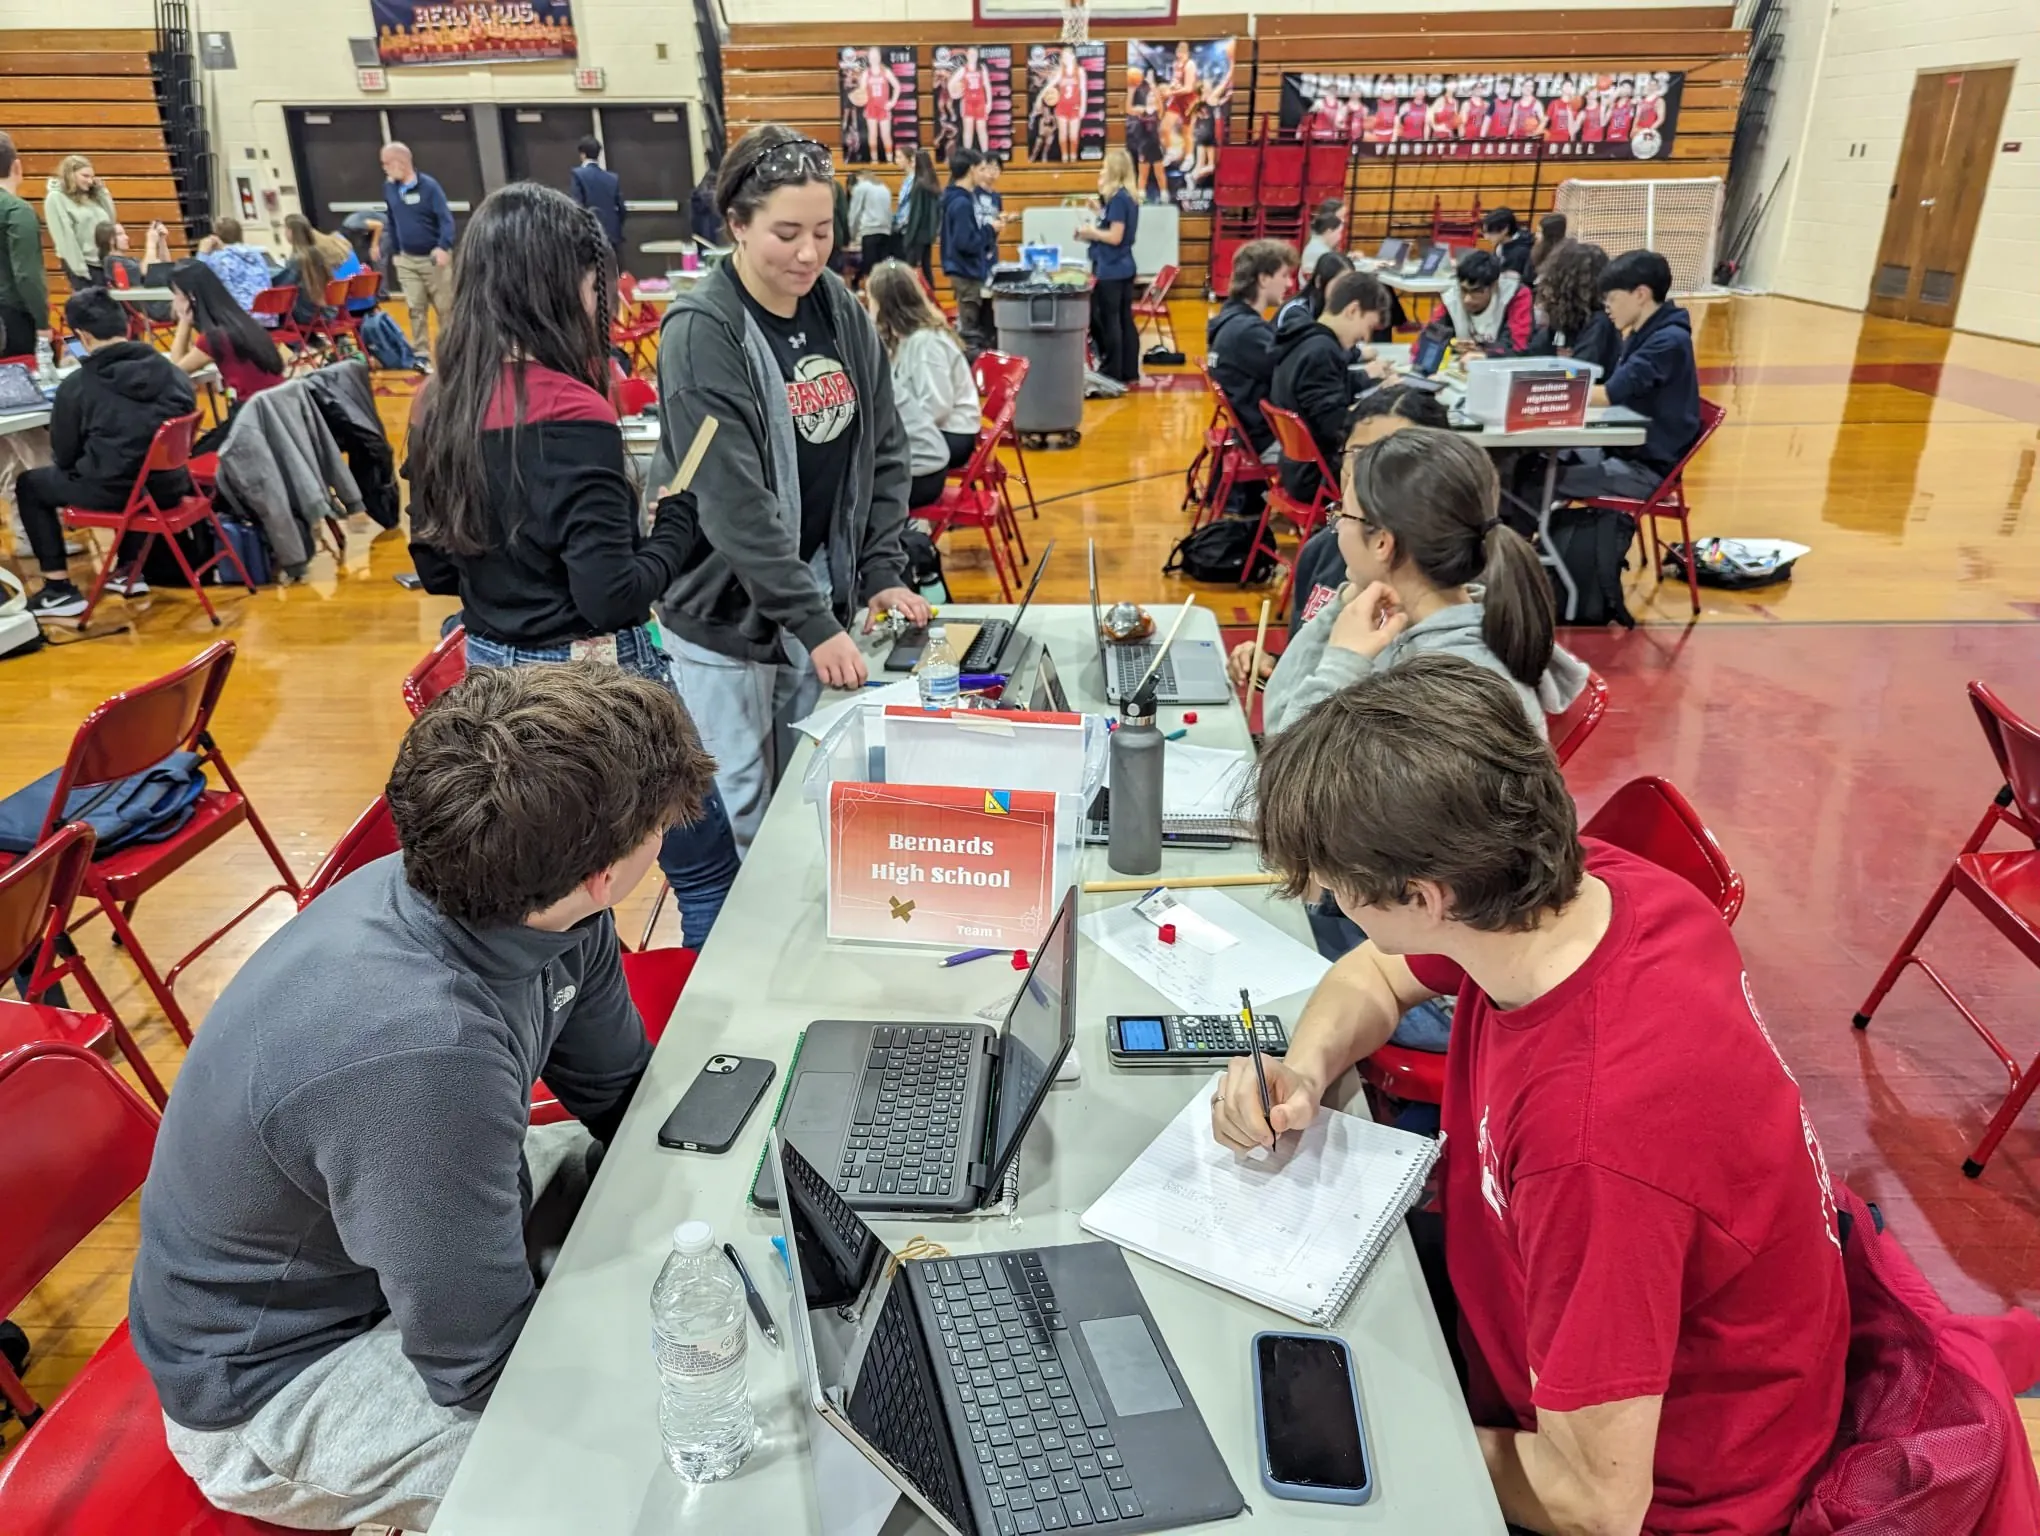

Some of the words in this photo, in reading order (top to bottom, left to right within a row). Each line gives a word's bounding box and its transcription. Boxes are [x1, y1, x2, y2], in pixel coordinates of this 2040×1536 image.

[1080, 57, 1106, 138] WHITE
[1374, 142, 1458, 156] VARSITY
[1470, 142, 1596, 156] BASKEBALL
[888, 833, 994, 856] Bernards
[871, 862, 925, 885] High
[930, 866, 1011, 888] School
[955, 925, 994, 938] Team
[996, 928, 1003, 938] 1
